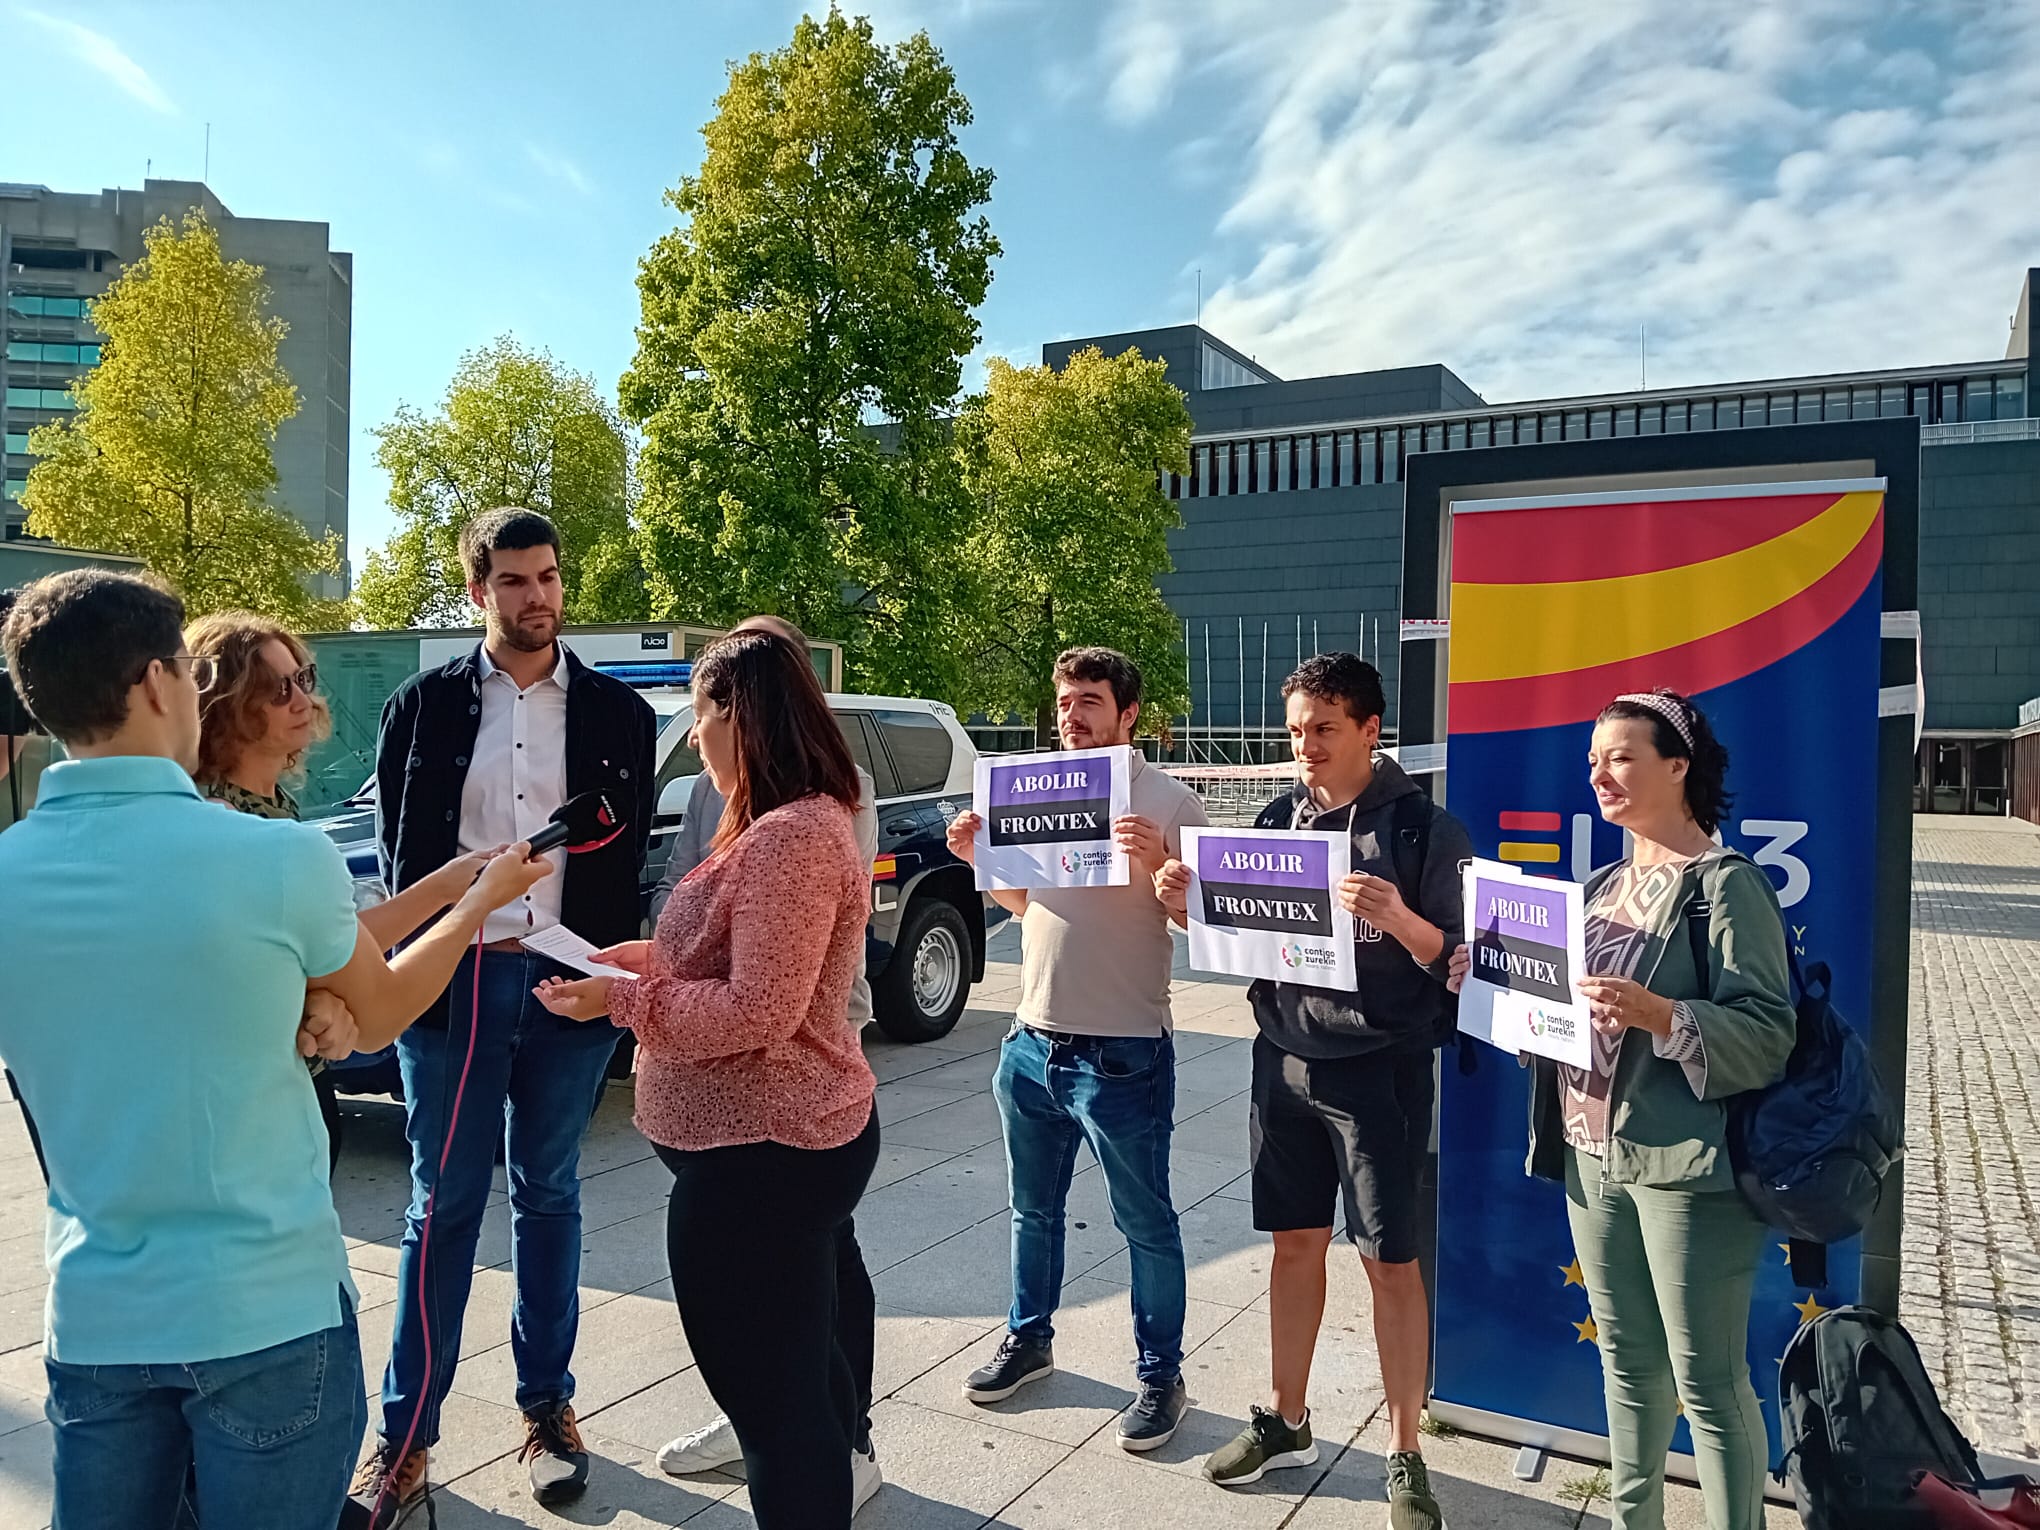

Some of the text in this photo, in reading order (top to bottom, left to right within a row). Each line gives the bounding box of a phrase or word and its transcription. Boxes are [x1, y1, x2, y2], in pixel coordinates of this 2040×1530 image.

[1010, 771, 1088, 793] ABOLIR
[1000, 811, 1098, 834] FRONTEX
[1082, 850, 1113, 861] contigo
[1083, 858, 1113, 866] zurekin
[1219, 851, 1304, 873] ABOLIR
[1213, 895, 1320, 922] FRONTEX
[1487, 896, 1550, 928] ABOLIR
[1304, 947, 1336, 959] contigo
[1305, 956, 1336, 966] zurekin
[1479, 945, 1560, 986] FRONTEX
[1546, 1015, 1575, 1030] contigo
[1547, 1024, 1576, 1038] zurekin
